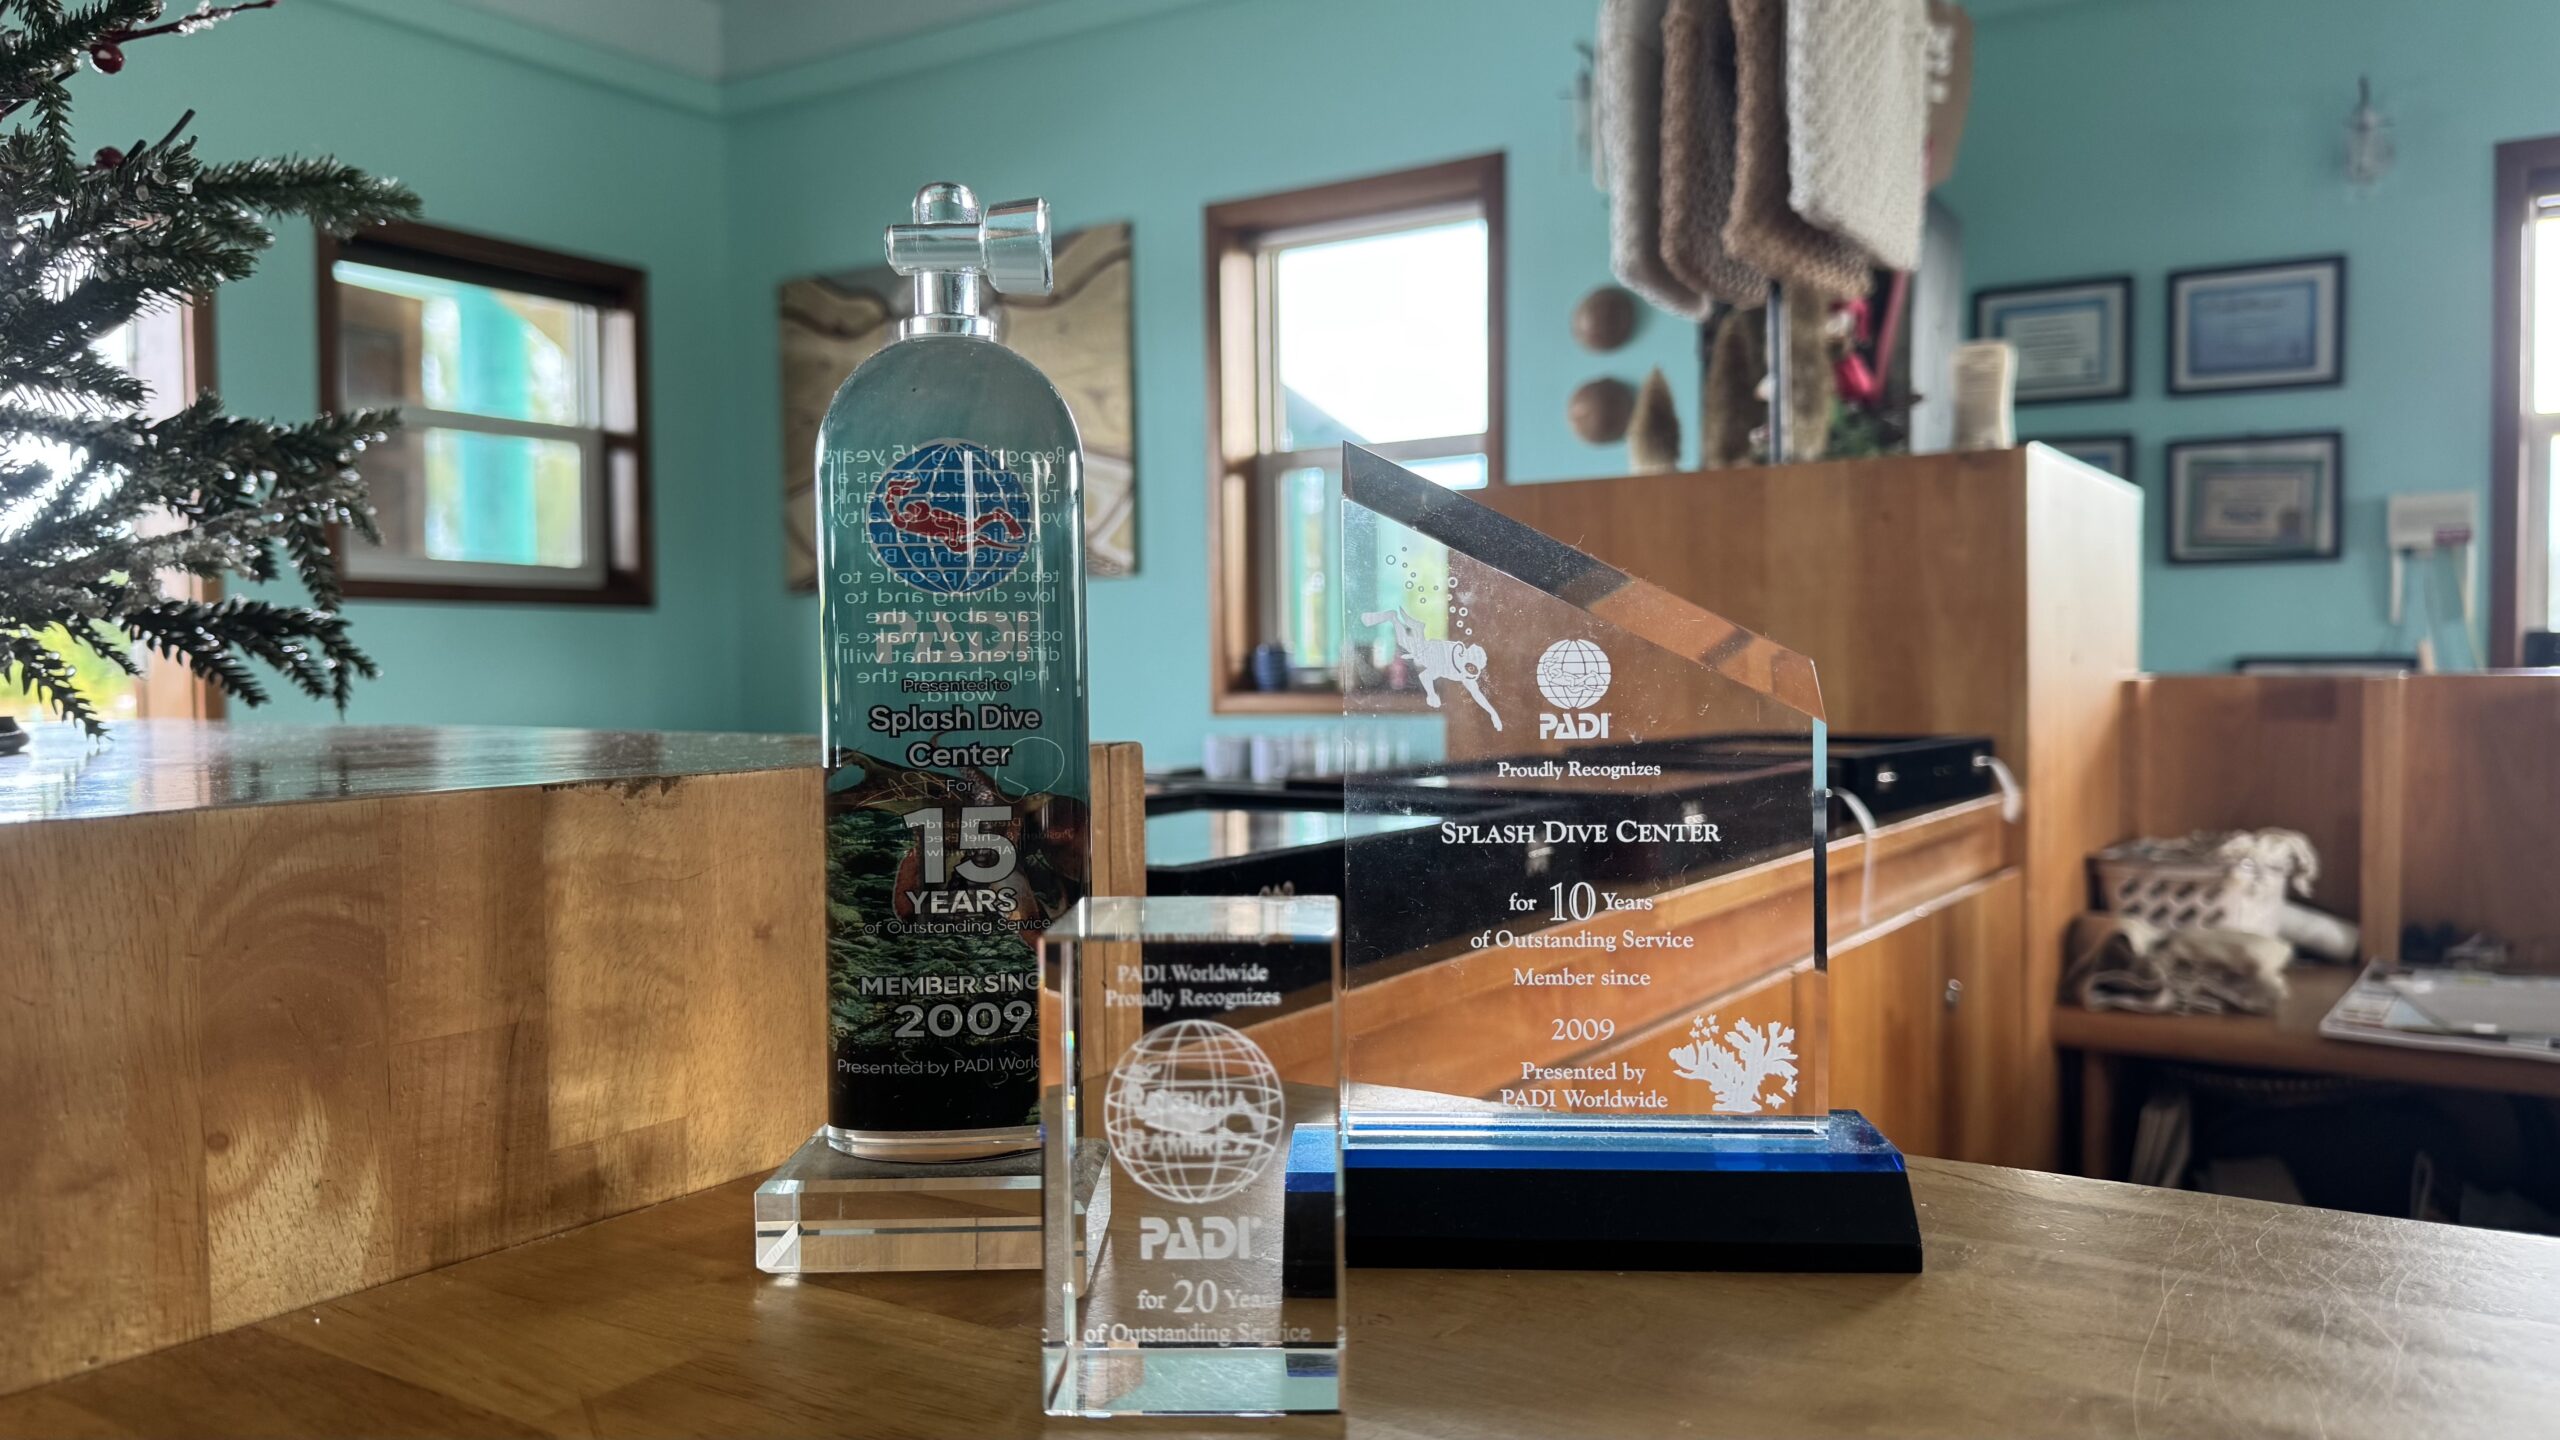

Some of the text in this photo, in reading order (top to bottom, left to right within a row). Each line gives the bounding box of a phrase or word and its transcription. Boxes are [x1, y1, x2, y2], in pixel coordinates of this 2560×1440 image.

[903, 680, 1010, 693] Presented to
[871, 704, 1041, 735] Splash Dive
[1539, 712, 1609, 740] PADI
[908, 743, 1012, 766] Center
[1497, 761, 1662, 780] Proudly Recognizes
[946, 779, 974, 792] For
[1441, 820, 1722, 844] SPLASH DIVE CENTER
[903, 806, 1017, 883] 15
[906, 889, 1018, 915] YEARS
[1508, 881, 1654, 921] for 10 Years
[864, 916, 1051, 937] of Outstanding Service
[1470, 930, 1695, 951] of Outstanding Service
[861, 972, 1040, 996] MEMBER SINC
[1117, 963, 1270, 983] PADI Worldwide
[1513, 967, 1651, 986] Member since
[1105, 987, 1282, 1011] Proudly Recognizes
[894, 1000, 1033, 1038] 2009
[1551, 1018, 1616, 1041] 2009
[837, 1055, 1040, 1077] Presented by PADI Worl
[1521, 1062, 1647, 1085] Presented by
[1500, 1088, 1669, 1109] PADI Worldwide
[1140, 1216, 1251, 1261] PADI
[1136, 1289, 1167, 1309] for
[1173, 1279, 1219, 1314] 20
[1084, 1323, 1312, 1347] of Outstanding Service
